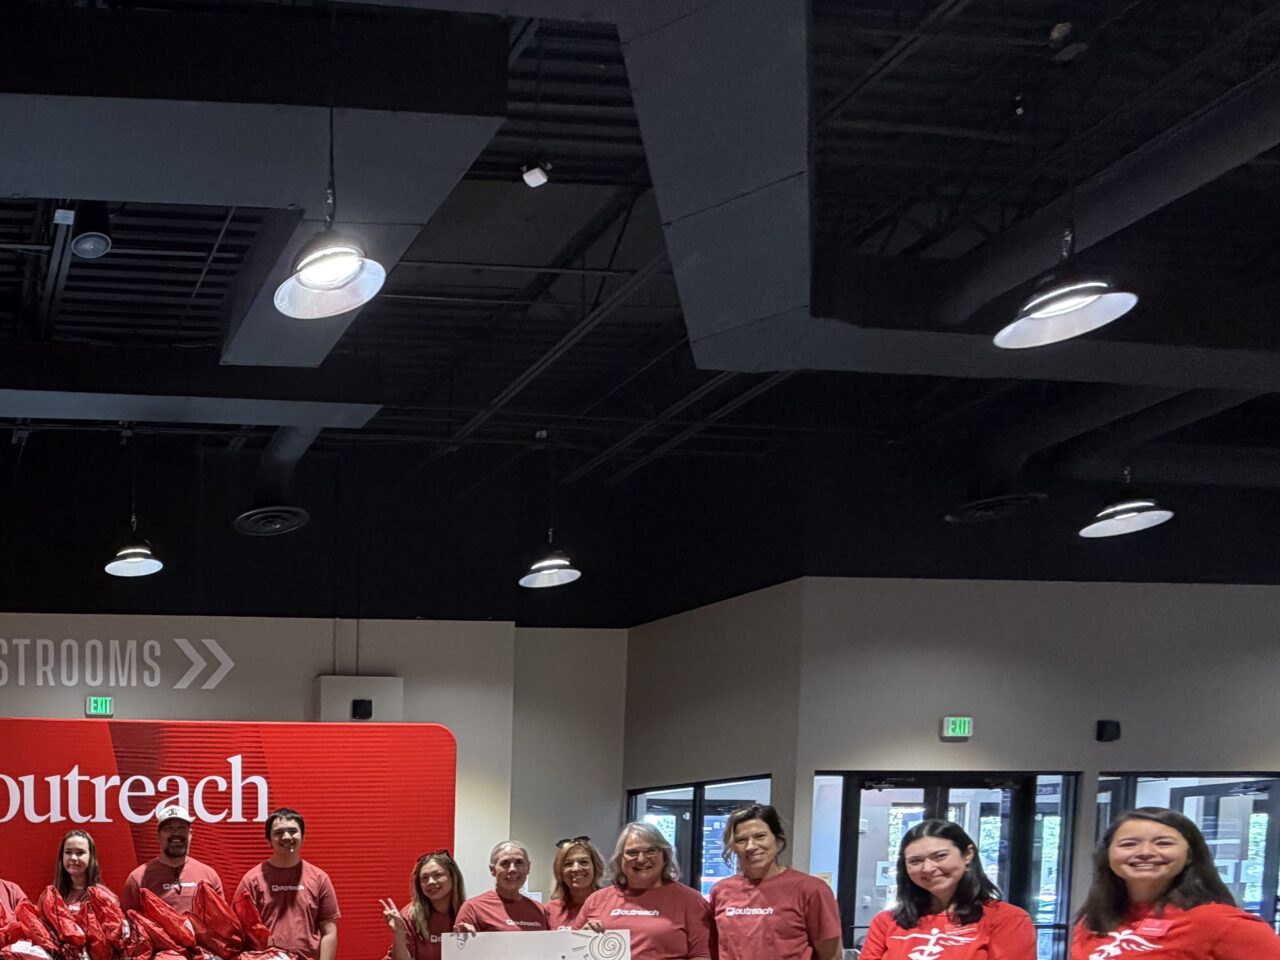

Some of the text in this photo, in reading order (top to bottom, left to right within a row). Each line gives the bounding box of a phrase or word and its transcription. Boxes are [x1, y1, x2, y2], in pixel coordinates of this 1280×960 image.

[91, 697, 111, 713] EXIT
[948, 718, 970, 735] EXIT
[735, 906, 774, 915] outreach
